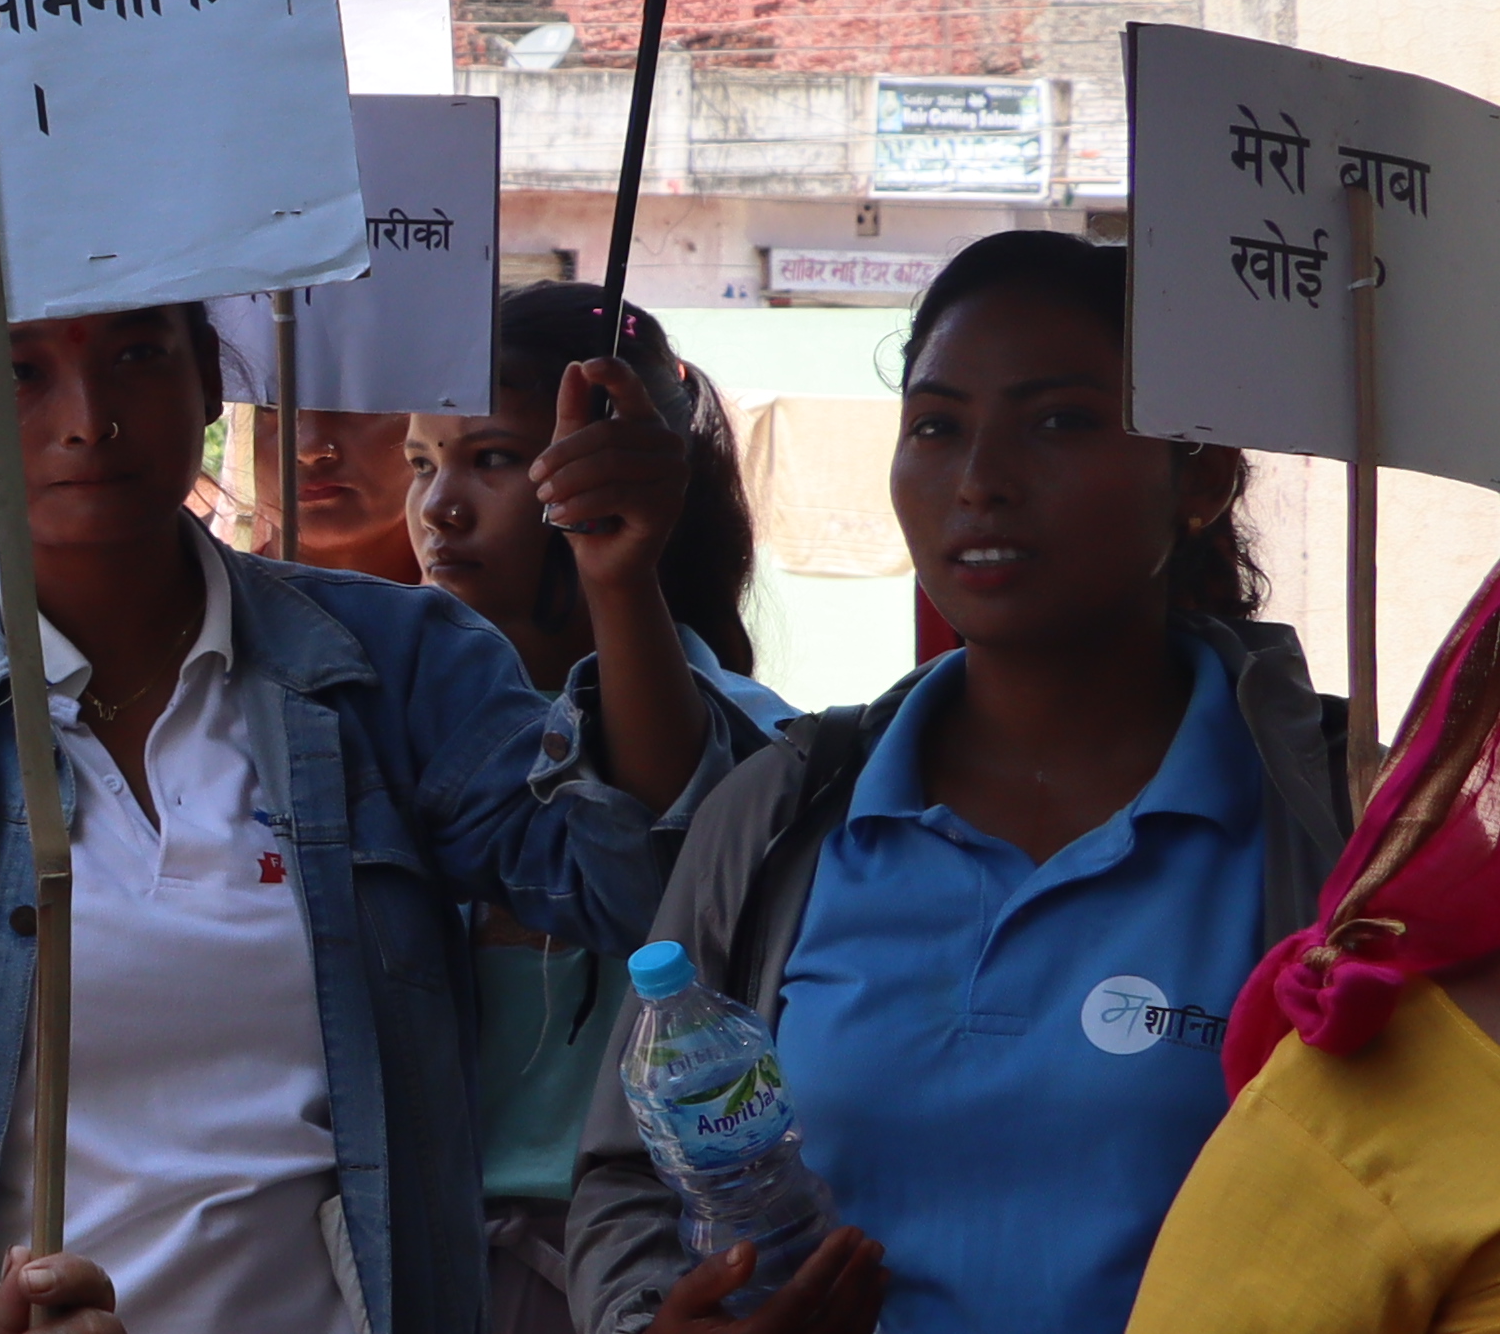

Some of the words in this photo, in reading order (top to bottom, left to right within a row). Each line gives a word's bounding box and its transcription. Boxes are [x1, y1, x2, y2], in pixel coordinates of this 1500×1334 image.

[1230, 104, 1310, 195] मेरो
[1338, 145, 1431, 220] बाबा
[1230, 219, 1329, 309] खोई
[697, 1098, 756, 1135] Amrit
